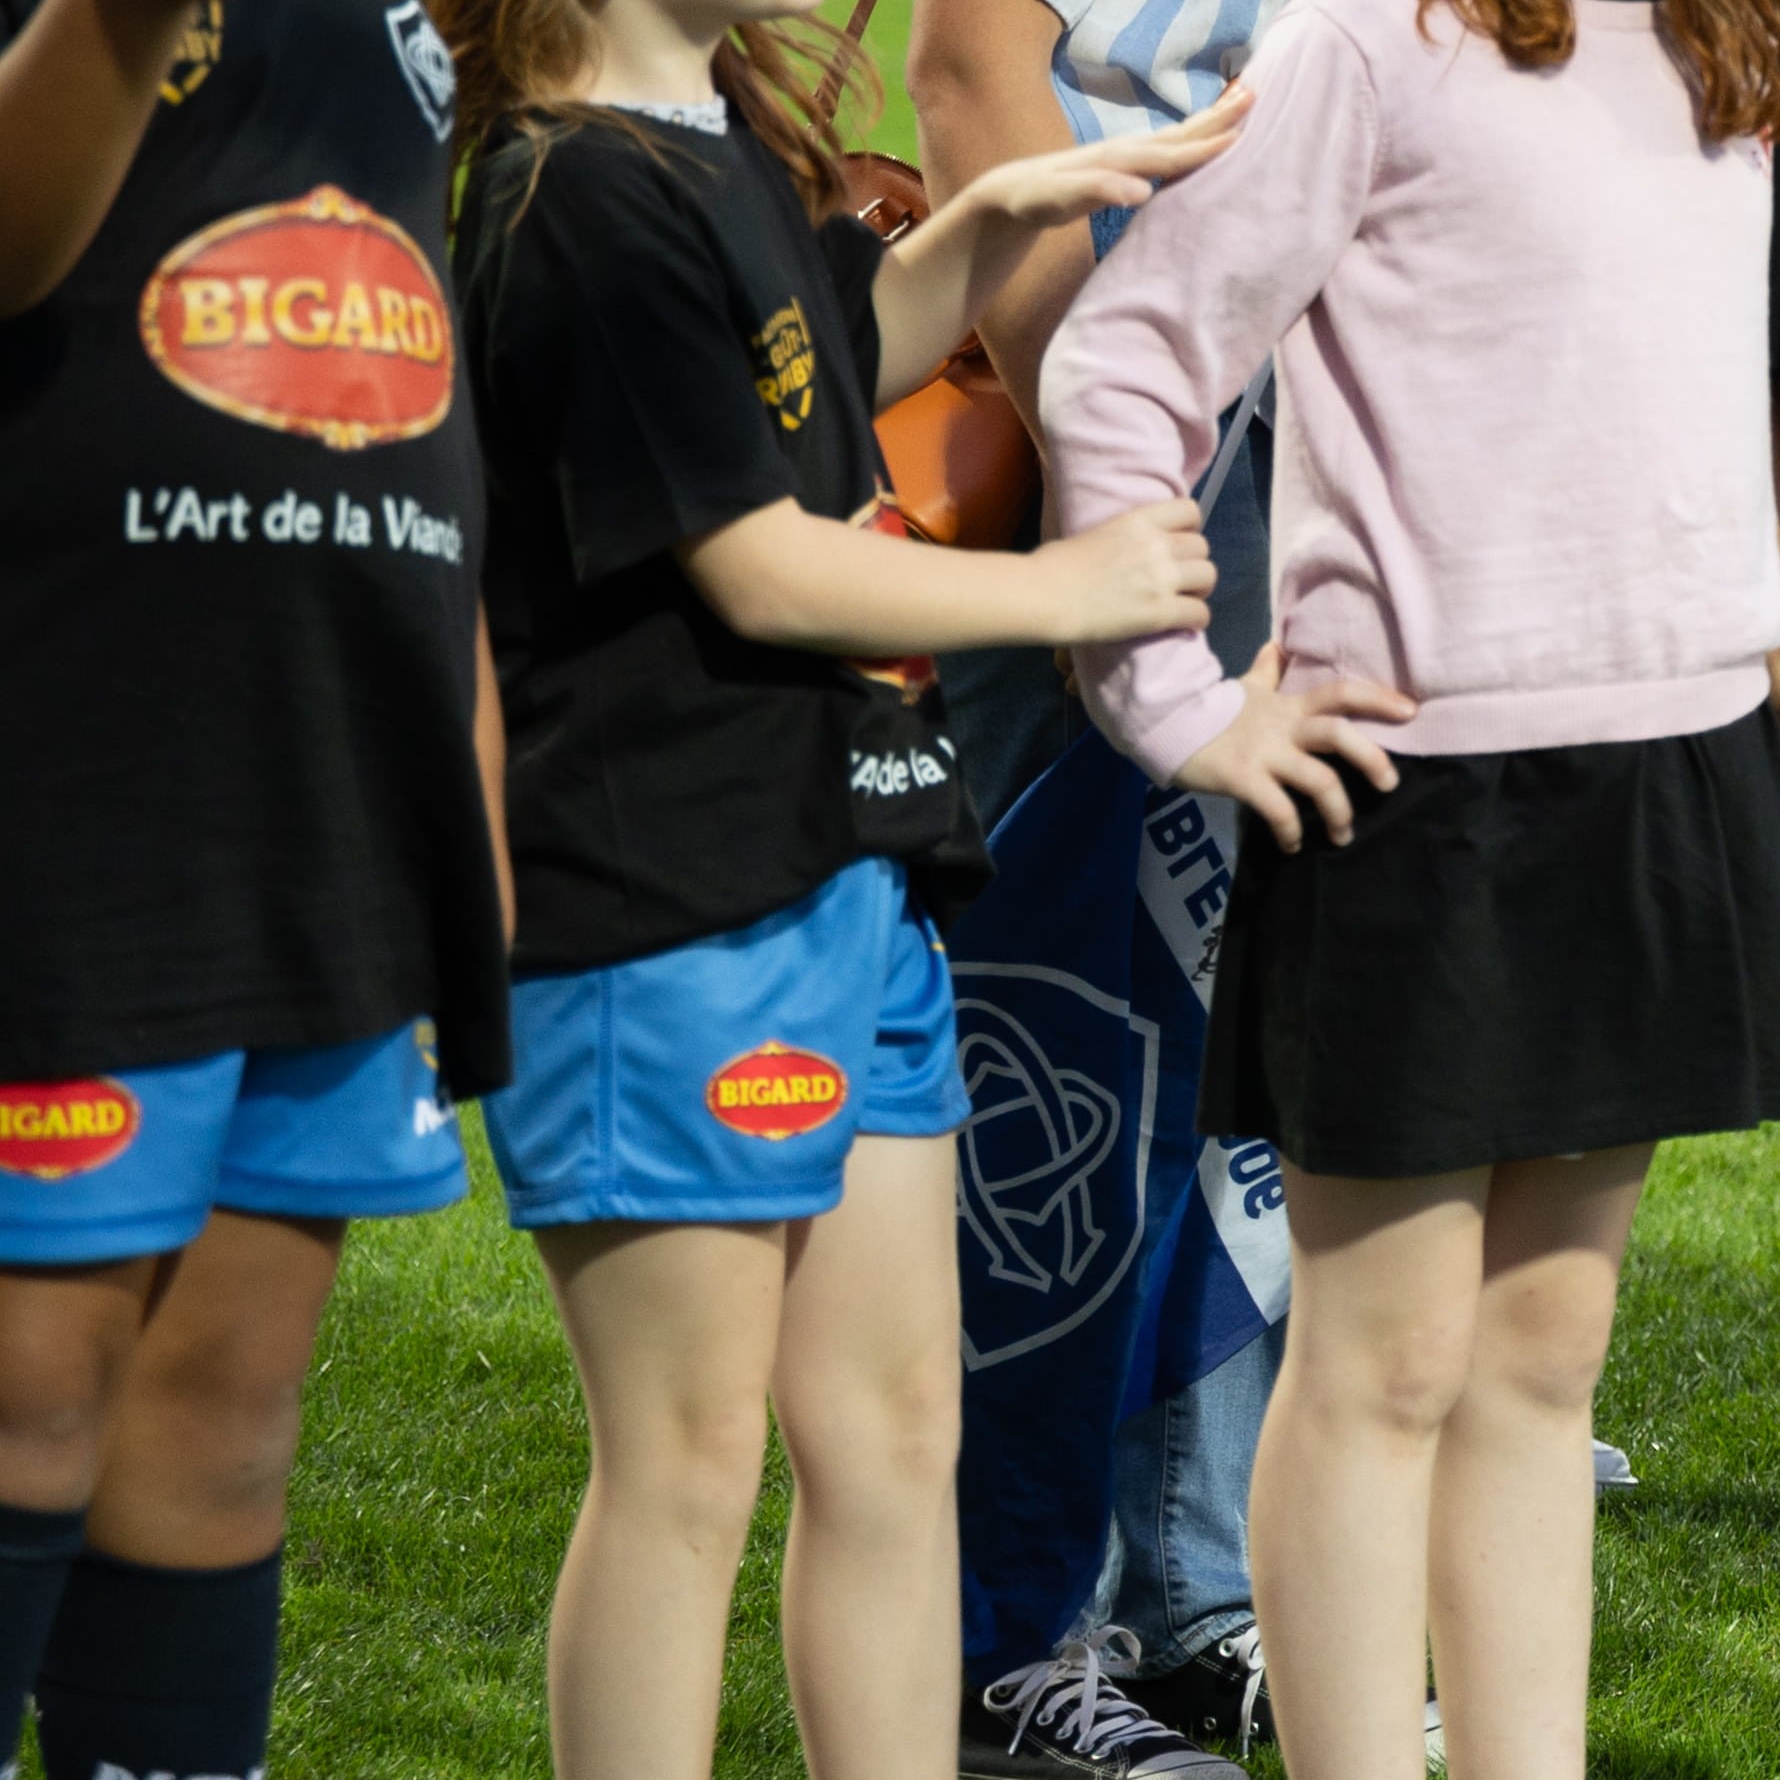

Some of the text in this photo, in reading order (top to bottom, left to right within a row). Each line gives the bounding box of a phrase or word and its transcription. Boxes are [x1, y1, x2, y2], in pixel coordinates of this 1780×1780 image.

[180, 278, 444, 367] BIGARD
[125, 485, 251, 542] L'Art
[262, 488, 323, 542] de
[334, 489, 373, 548] la
[716, 1072, 839, 1110] BIGARD
